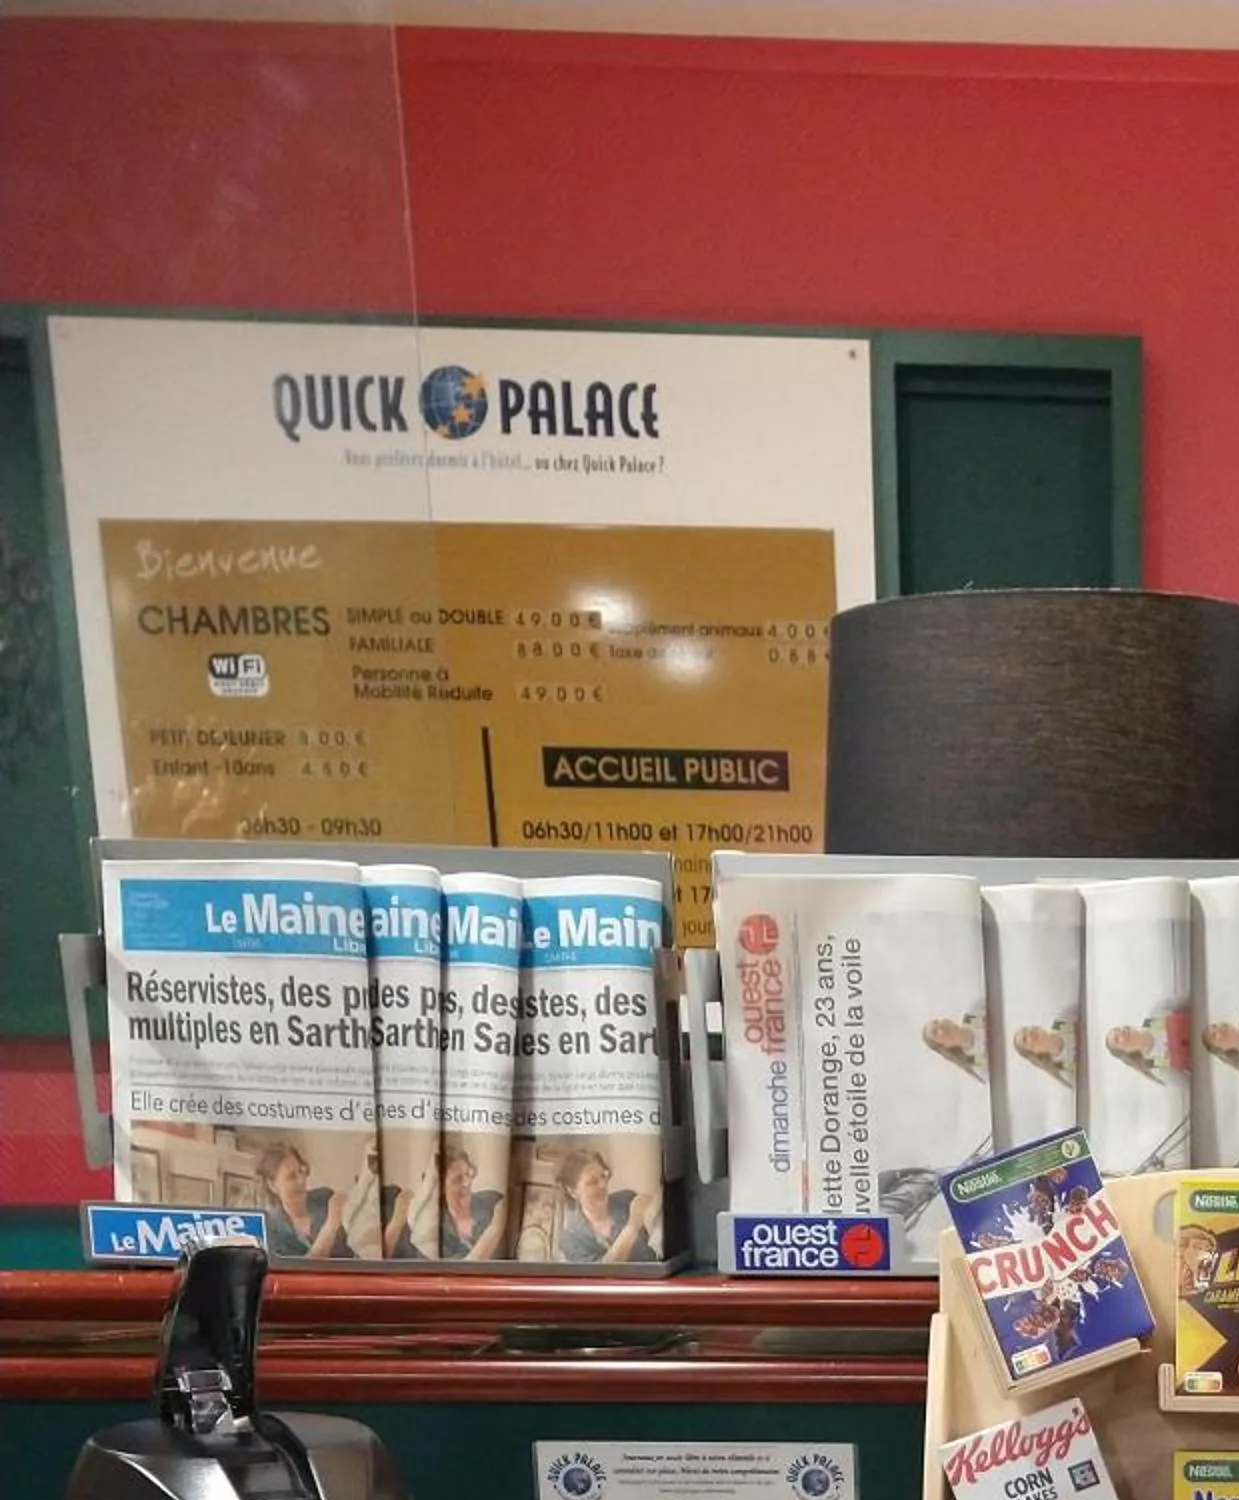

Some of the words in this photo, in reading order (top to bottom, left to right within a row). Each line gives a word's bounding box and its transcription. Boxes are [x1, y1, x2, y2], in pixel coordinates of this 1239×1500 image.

[272, 374, 408, 442] QUICK
[499, 379, 659, 439] PALACE
[554, 453, 578, 471] chez
[582, 453, 616, 476] Quick
[135, 539, 323, 580] Bienvenue
[138, 605, 332, 636] CHAMBRES
[438, 607, 505, 625] DOUBLE
[349, 637, 435, 654] FAMILIALE
[352, 663, 432, 681] Personne
[353, 682, 423, 701] Mobilité
[153, 758, 209, 776] Enfant
[553, 755, 677, 783] ACCUEIL
[684, 758, 779, 784] PUBLIC
[321, 817, 382, 837] 09h30
[522, 820, 653, 842] 06h30/11h00
[659, 823, 678, 841] et
[686, 823, 813, 845] 17h00/21h00
[205, 902, 237, 934] Le
[242, 892, 366, 938] Maine
[372, 896, 441, 940] aine
[448, 905, 519, 949] Mai
[558, 906, 662, 950] Main
[815, 934, 838, 990] ans,
[841, 937, 866, 998] voile
[127, 969, 275, 1012] Réservistes,
[281, 975, 331, 1007] des
[519, 986, 587, 1021] stes,
[594, 985, 647, 1017] des
[737, 959, 764, 1044] ouest
[761, 958, 785, 1056] france
[816, 995, 836, 1028] 23
[843, 1005, 865, 1028] la
[128, 1010, 242, 1049] multiples
[250, 1019, 280, 1046] en
[287, 1014, 370, 1049] Sarth
[371, 1015, 440, 1048] Sarth
[474, 1022, 514, 1057] Sa
[559, 1030, 591, 1055] en
[599, 1023, 660, 1056] Sart
[844, 1033, 866, 1068] de
[130, 1090, 164, 1112] Elle
[168, 1093, 207, 1115] crée
[213, 1096, 244, 1117] des
[248, 1099, 333, 1122] costumes
[820, 1034, 844, 1154] Dorange,
[846, 1072, 870, 1143] étoile
[552, 1104, 644, 1126] costumes
[767, 1060, 791, 1173] dimanche
[822, 1158, 844, 1215] lette
[110, 1231, 136, 1253] Le
[136, 1214, 246, 1254] Maine
[752, 1219, 839, 1246] ouest
[970, 1198, 1120, 1294] CRUNCH
[741, 1239, 840, 1268] france
[945, 1408, 1093, 1486] Kellogg's
[1004, 1467, 1054, 1499] CORN
